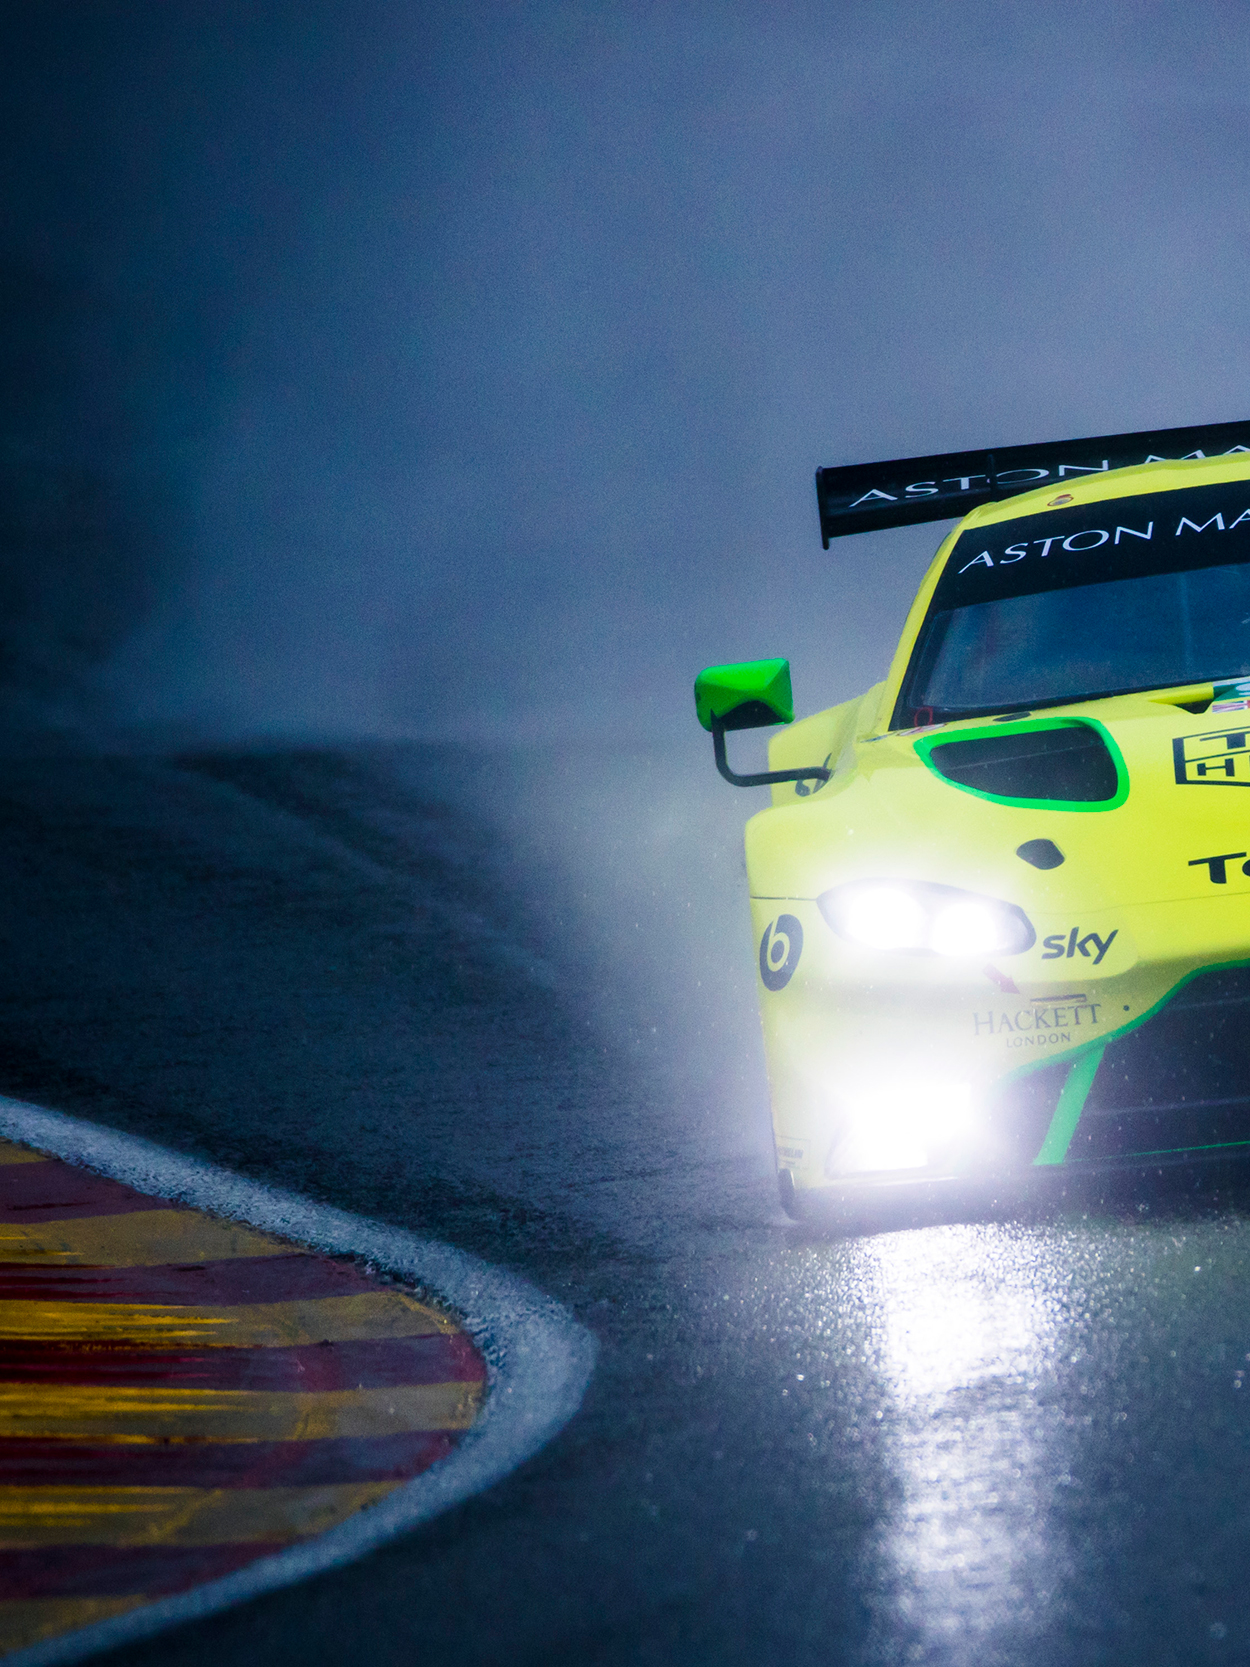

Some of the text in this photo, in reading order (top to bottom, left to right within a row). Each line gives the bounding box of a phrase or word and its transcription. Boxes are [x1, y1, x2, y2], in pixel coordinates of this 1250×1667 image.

[849, 459, 1110, 508] ASTON
[958, 521, 1155, 575] ASTON
[1041, 927, 1119, 965] sky
[973, 1003, 1102, 1036] HACKETT
[1006, 1031, 1071, 1049] LONDON
